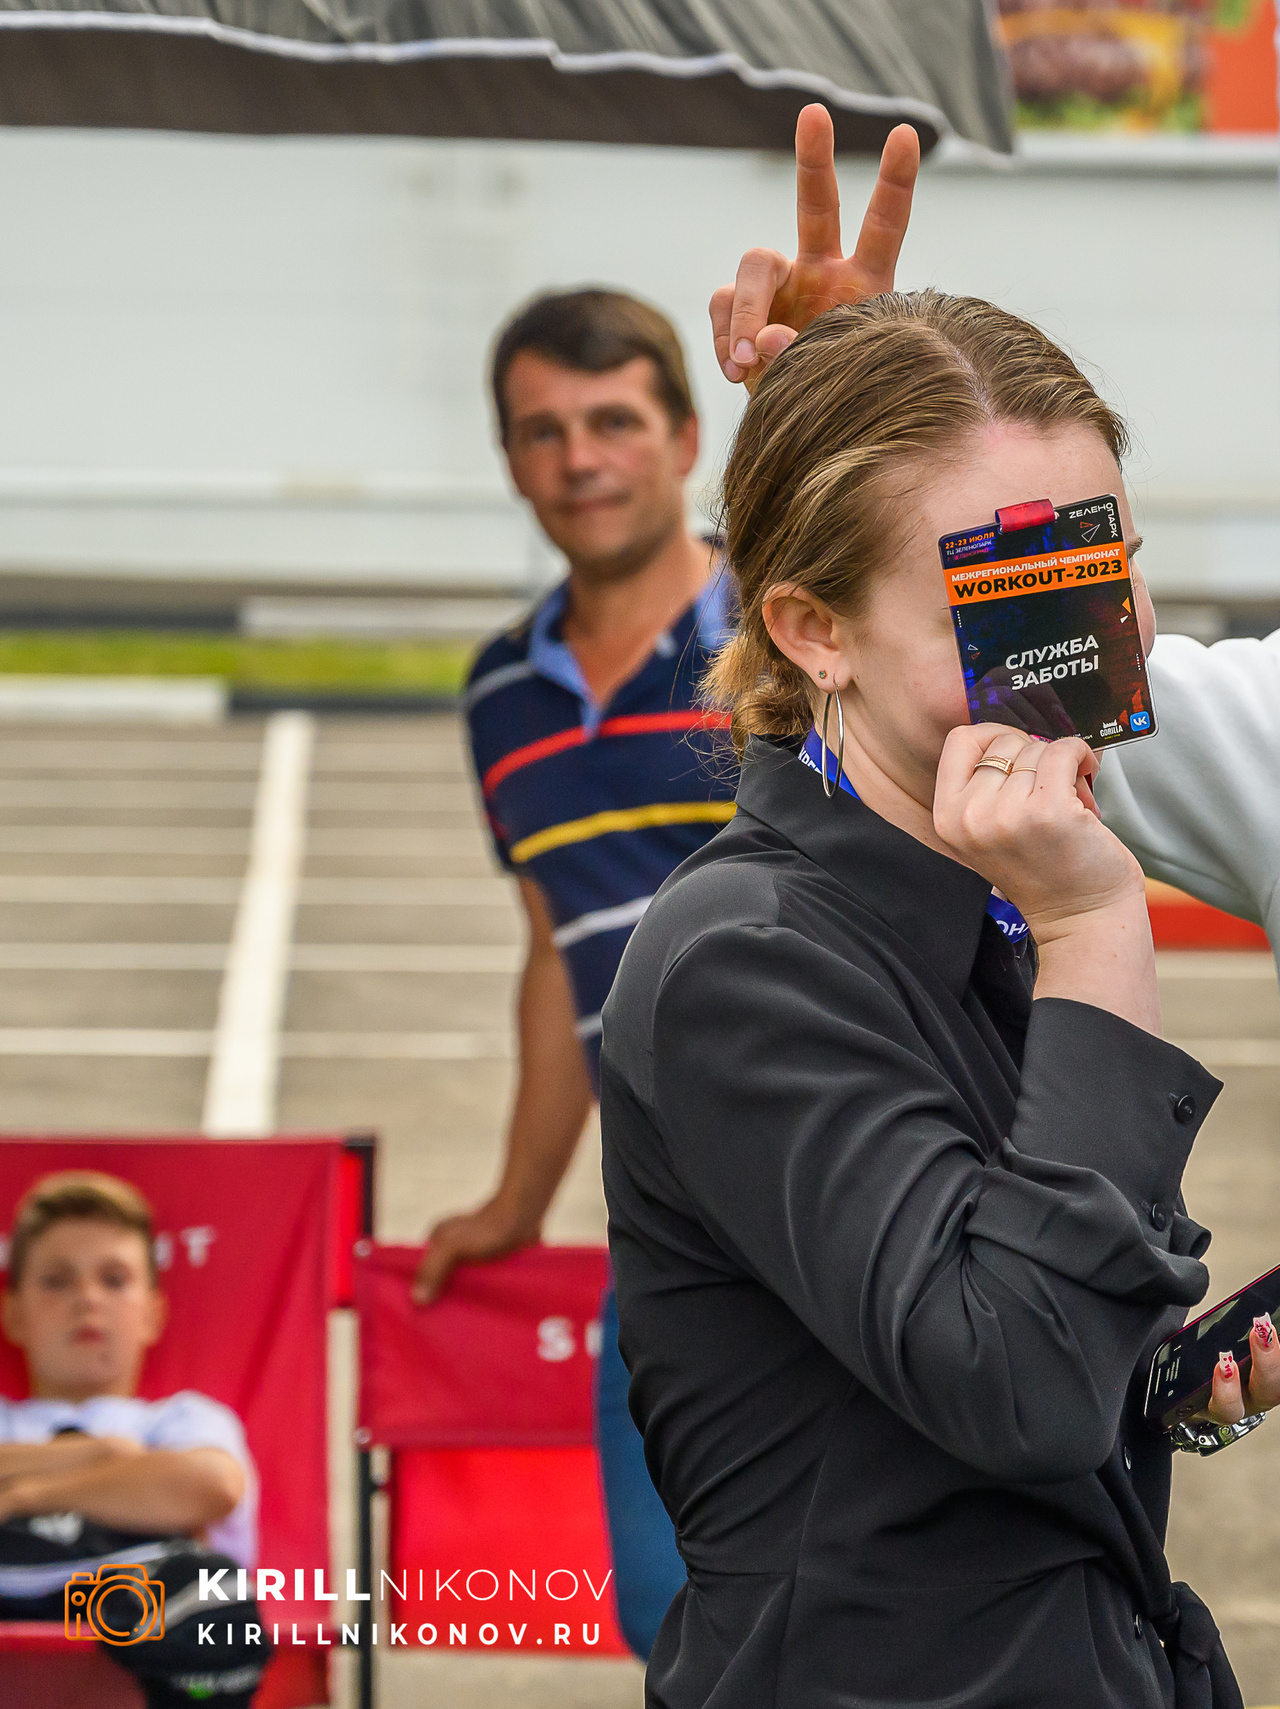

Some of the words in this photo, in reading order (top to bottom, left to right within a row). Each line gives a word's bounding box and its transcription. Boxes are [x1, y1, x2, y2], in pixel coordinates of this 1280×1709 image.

[945, 538, 967, 550] 22-23
[969, 531, 995, 544] ИЮЛЯ
[951, 556, 1058, 582] МЕЖРЕГИОНАЛЬНЫЙ
[1059, 548, 1121, 565] ЧЕМПИОНАТ
[954, 559, 1123, 599] WORKOUT-2023
[1005, 634, 1100, 670] СЛУЖБА
[1011, 655, 1100, 691] ЗАБОТЫ
